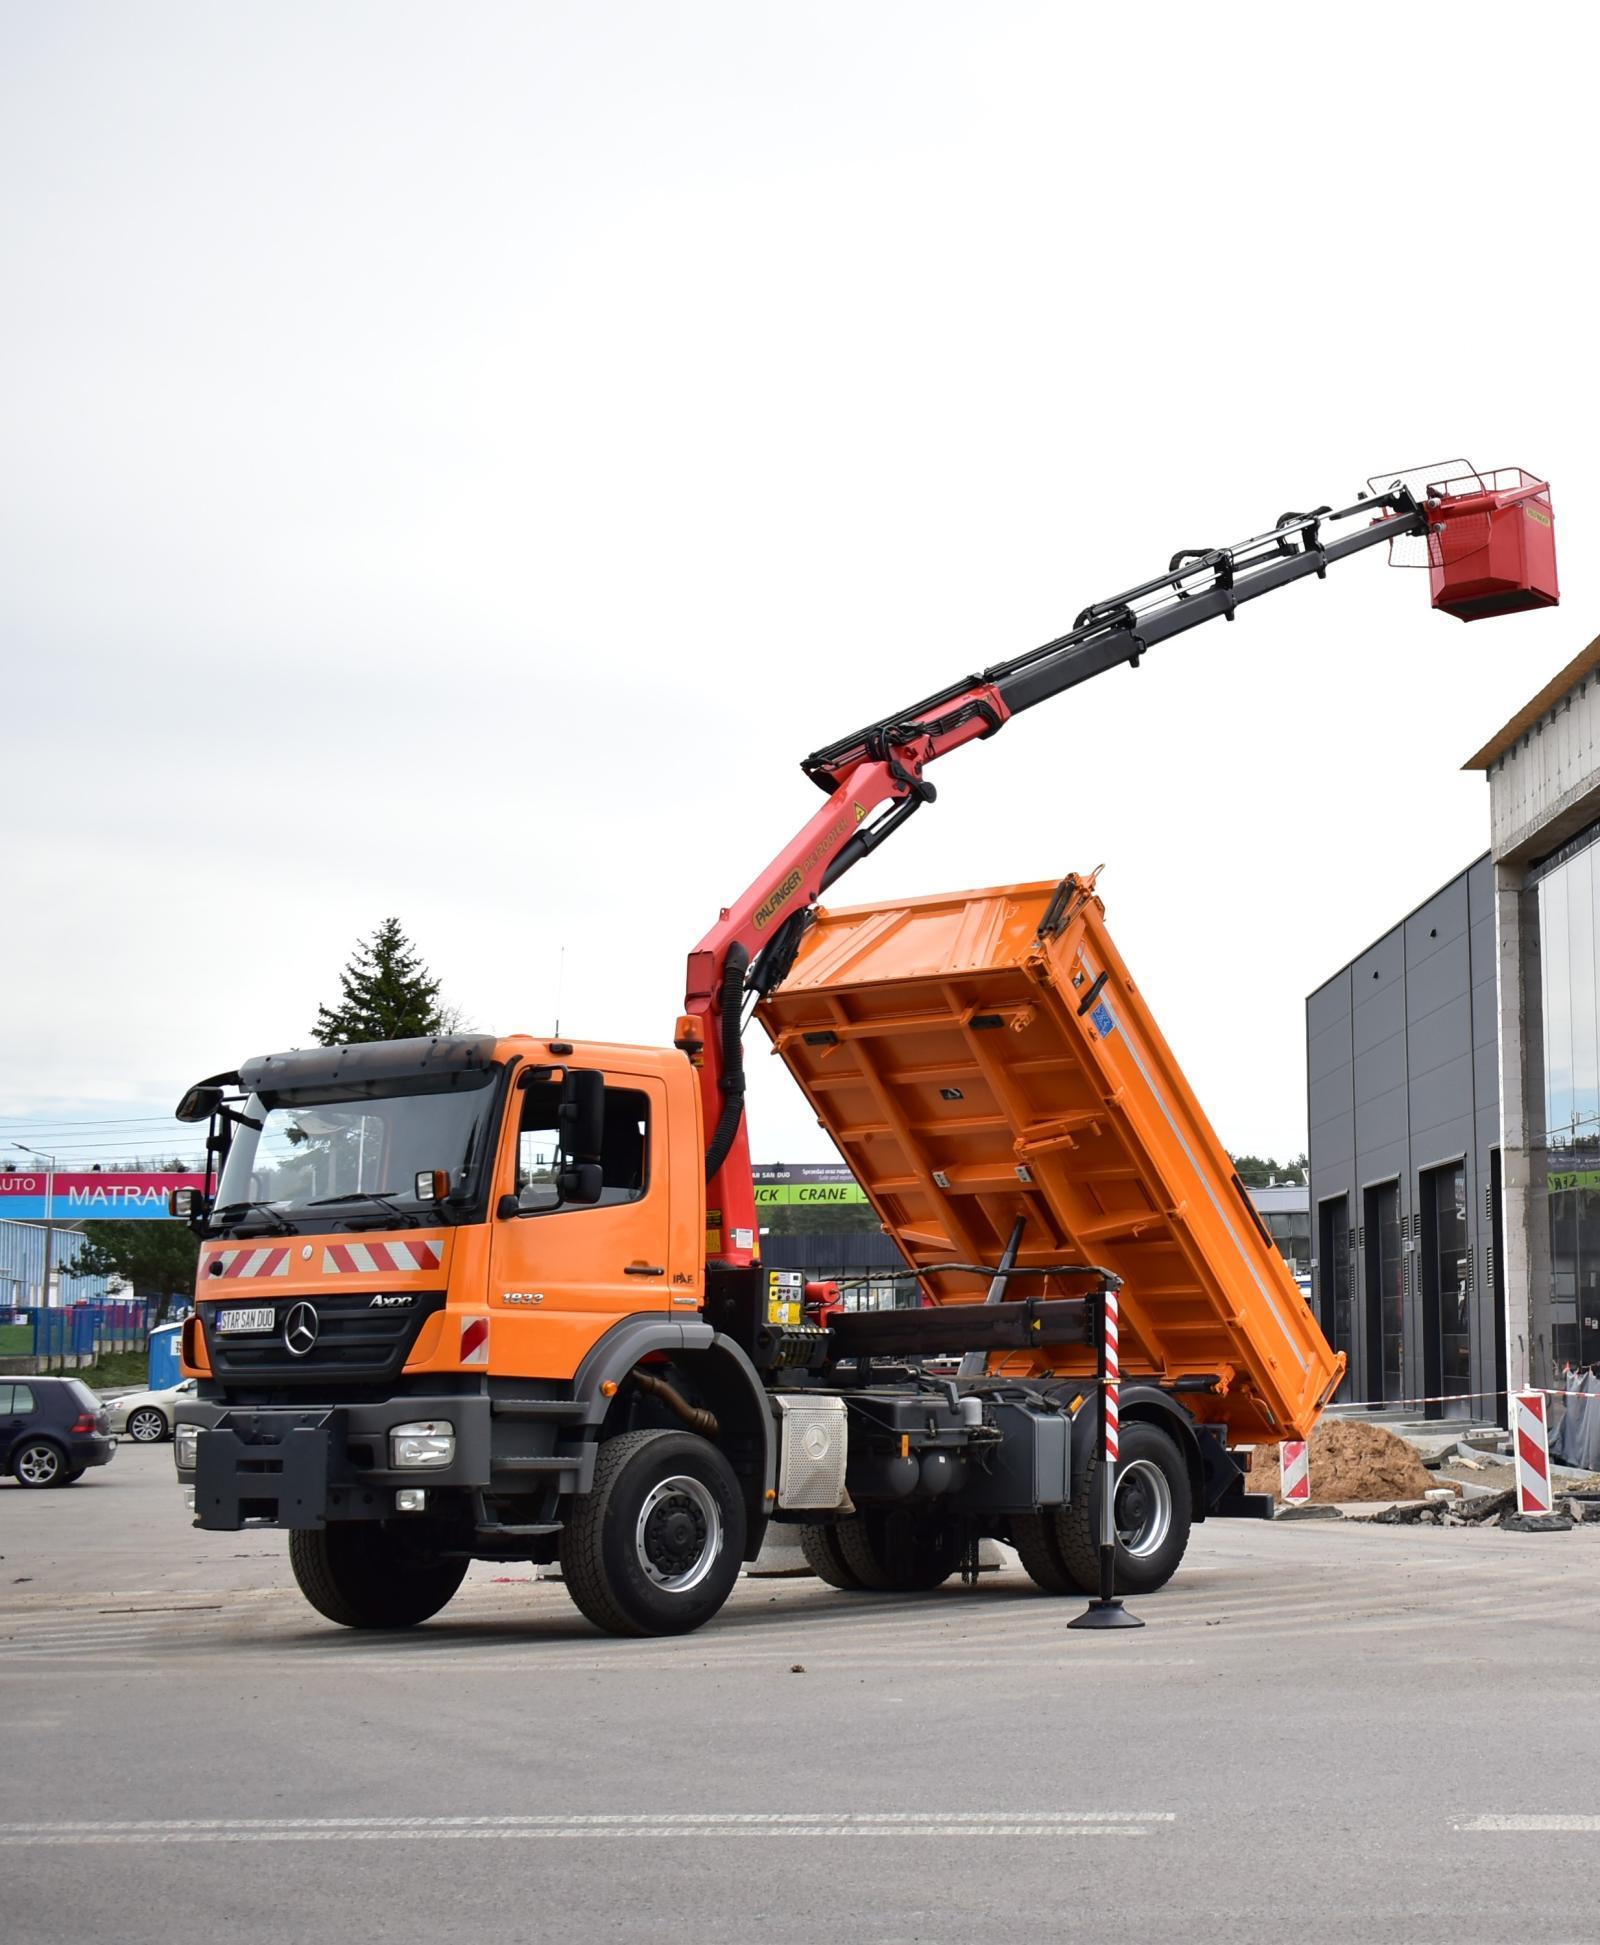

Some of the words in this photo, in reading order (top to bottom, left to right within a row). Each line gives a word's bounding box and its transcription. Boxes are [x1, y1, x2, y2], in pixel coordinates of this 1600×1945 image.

[756, 871, 801, 926] PALFINGER
[0, 1178, 36, 1191] UTO
[799, 1188, 848, 1201] CRANE
[69, 1186, 197, 1206] MATRAN
[222, 1311, 240, 1329] STAR
[241, 1310, 256, 1328] SAN
[257, 1309, 273, 1327] DUO
